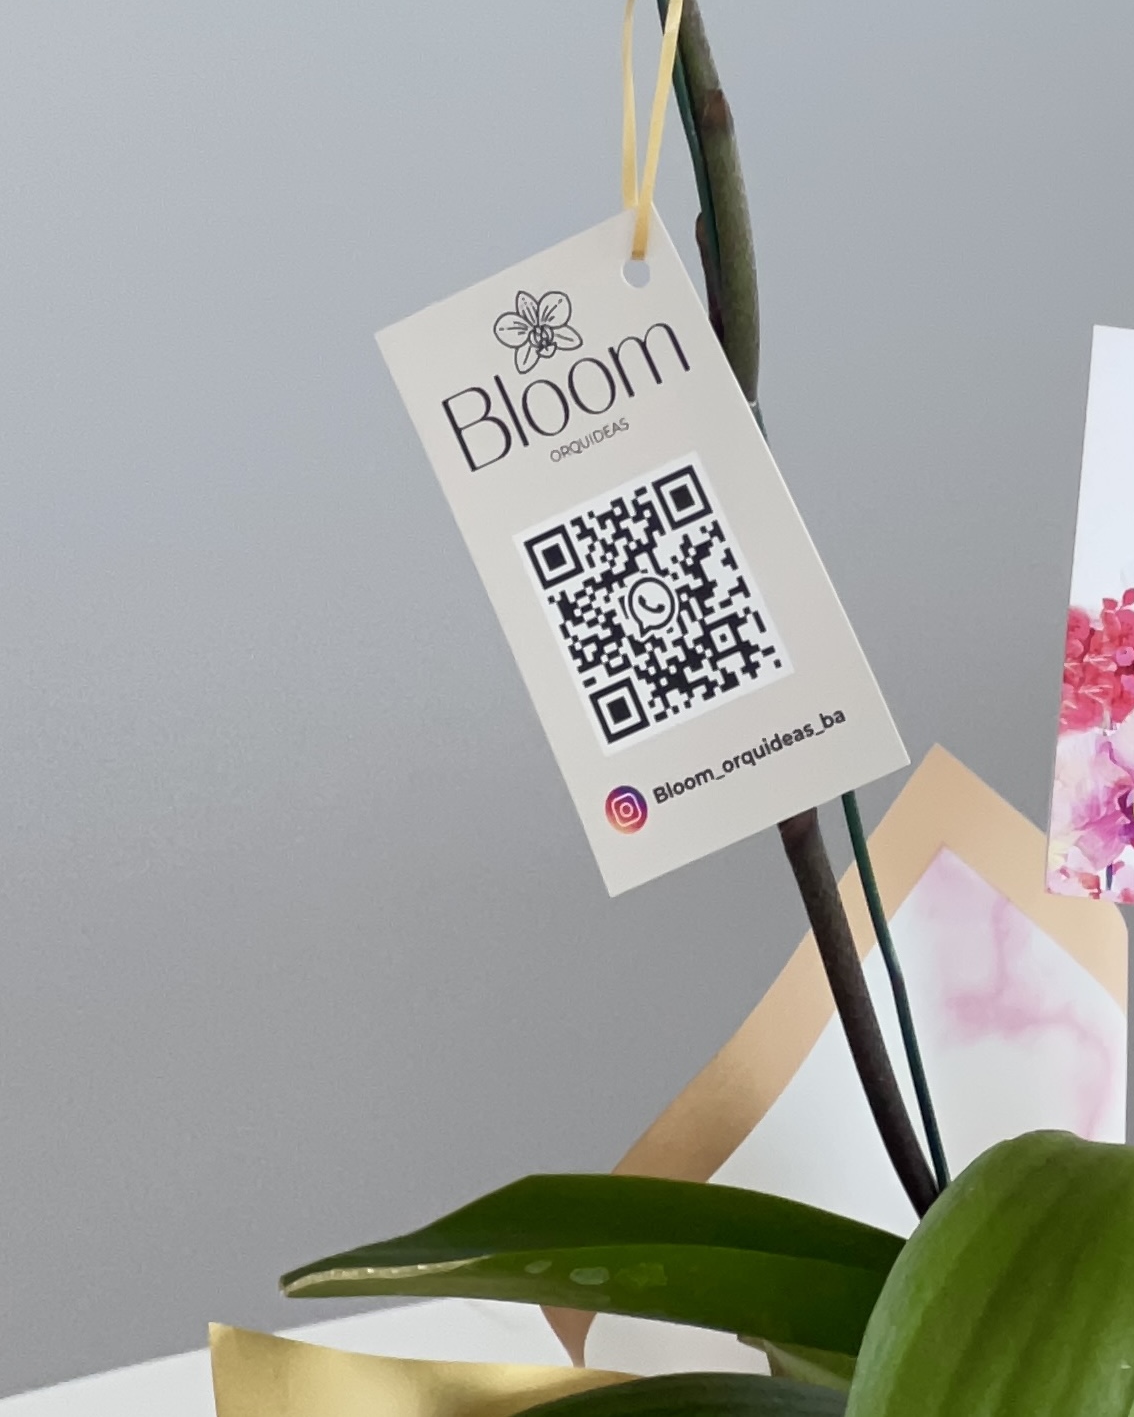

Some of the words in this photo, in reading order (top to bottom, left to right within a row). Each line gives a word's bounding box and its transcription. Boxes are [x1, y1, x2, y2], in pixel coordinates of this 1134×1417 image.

[441, 322, 691, 472] Bloom
[549, 417, 630, 463] ORQUIDEAS
[653, 709, 846, 804] Bloom_orquideas_ba
